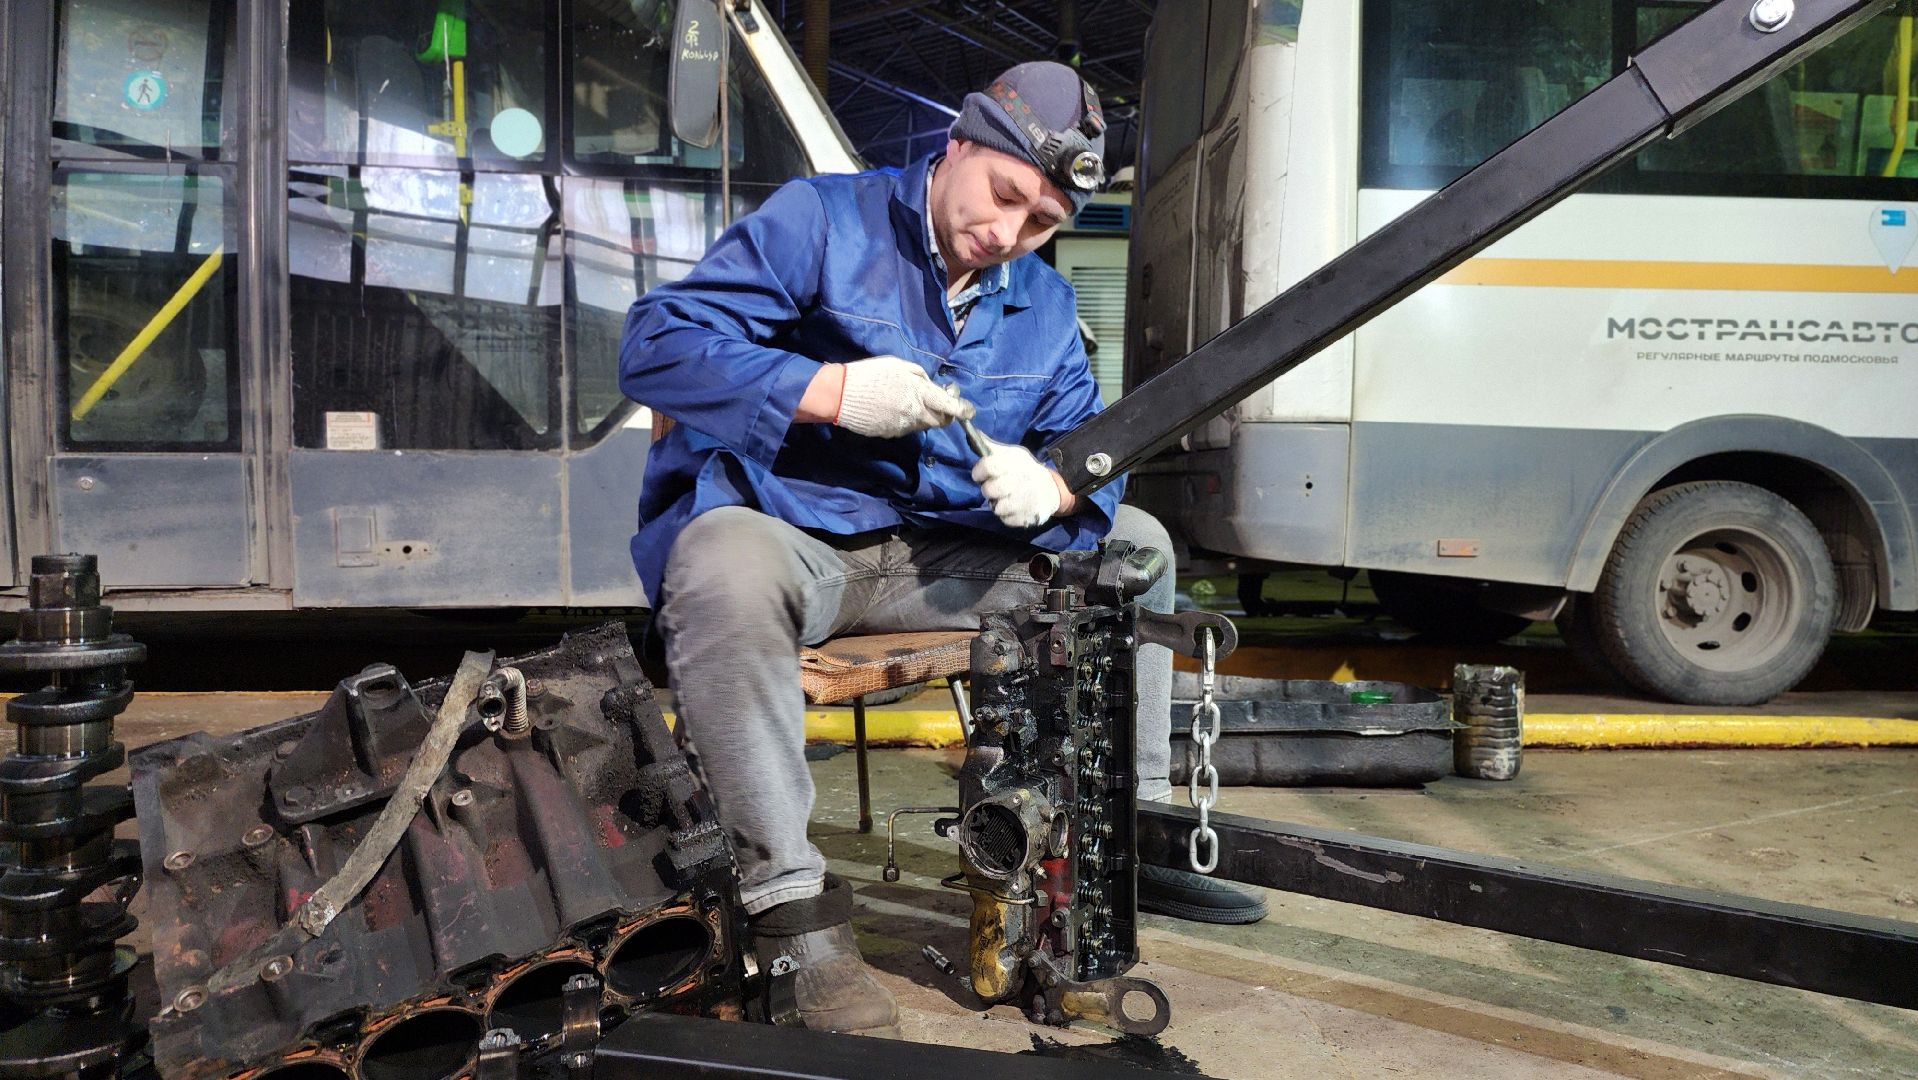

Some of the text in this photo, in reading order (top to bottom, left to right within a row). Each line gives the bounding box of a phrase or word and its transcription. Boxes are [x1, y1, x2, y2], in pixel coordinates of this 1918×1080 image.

[688, 20, 699, 33] 2
[1607, 317, 1918, 344] МОСТРАНСАВТО
[1637, 351, 1899, 364] РЕГУЛЯРНЫЕ МАРШРУТЫ ПОДМОСКОВЬЯ
